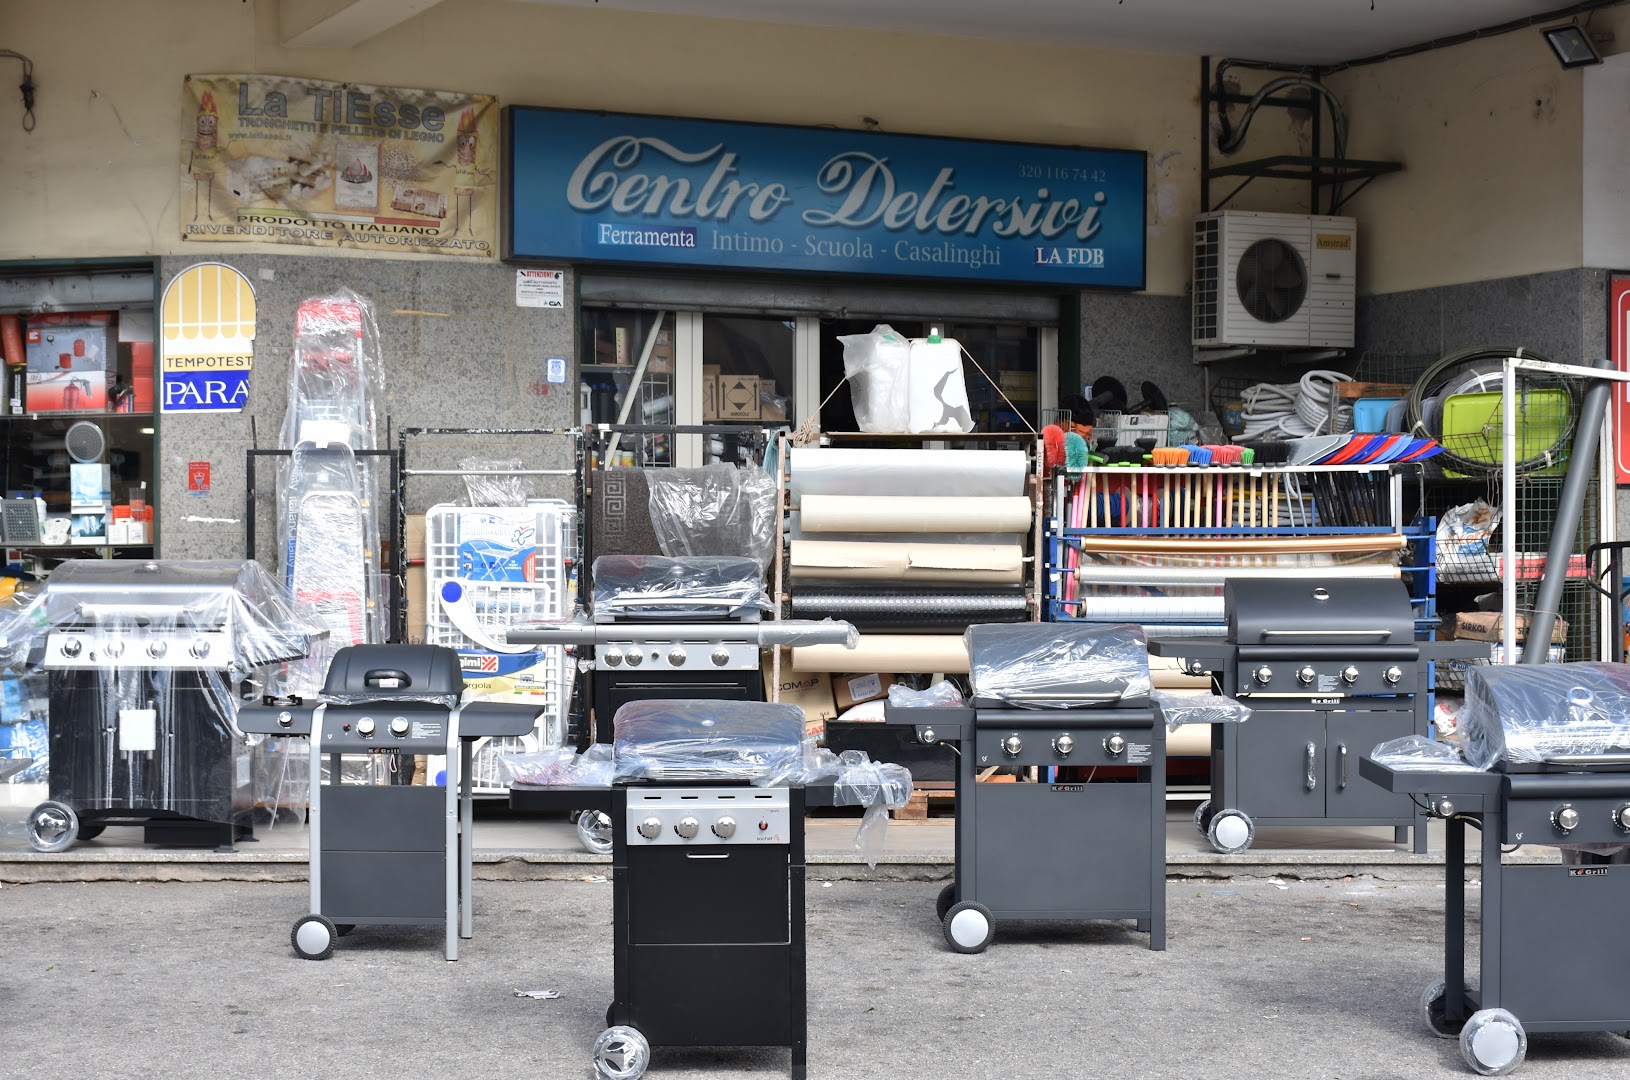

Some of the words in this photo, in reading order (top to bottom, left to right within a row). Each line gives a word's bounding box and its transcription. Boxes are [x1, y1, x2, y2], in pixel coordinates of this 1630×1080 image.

[238, 82, 288, 118] La
[307, 87, 445, 132] TiEsse
[238, 117, 316, 133] TRONCHETTI
[319, 124, 328, 133] E
[331, 124, 385, 138] PELLETS
[389, 129, 401, 139] DI
[404, 131, 445, 143] LEGNO
[1019, 164, 1042, 178] 320
[1047, 166, 1068, 180] 116
[1072, 168, 1087, 181] 74
[1091, 169, 1106, 182] 42
[566, 135, 791, 220] Centro
[802, 151, 1106, 240] Detersivi
[237, 216, 345, 229] PRODOTTO
[351, 223, 440, 236] ITALIANO
[186, 225, 334, 240] RIVENDITORE
[341, 232, 490, 251] AUTORIZZATO
[599, 223, 696, 248] Ferramenta
[712, 230, 783, 253] Intimo
[805, 235, 874, 259] Scuola
[894, 240, 1001, 268] Casalinghi
[1316, 238, 1348, 248] Amstrad
[1036, 247, 1063, 264] LA
[1066, 247, 1104, 265] FDB
[166, 356, 253, 368] TEMPOTEST
[165, 379, 251, 405] PARA
[1461, 622, 1487, 633] SIRKOL
